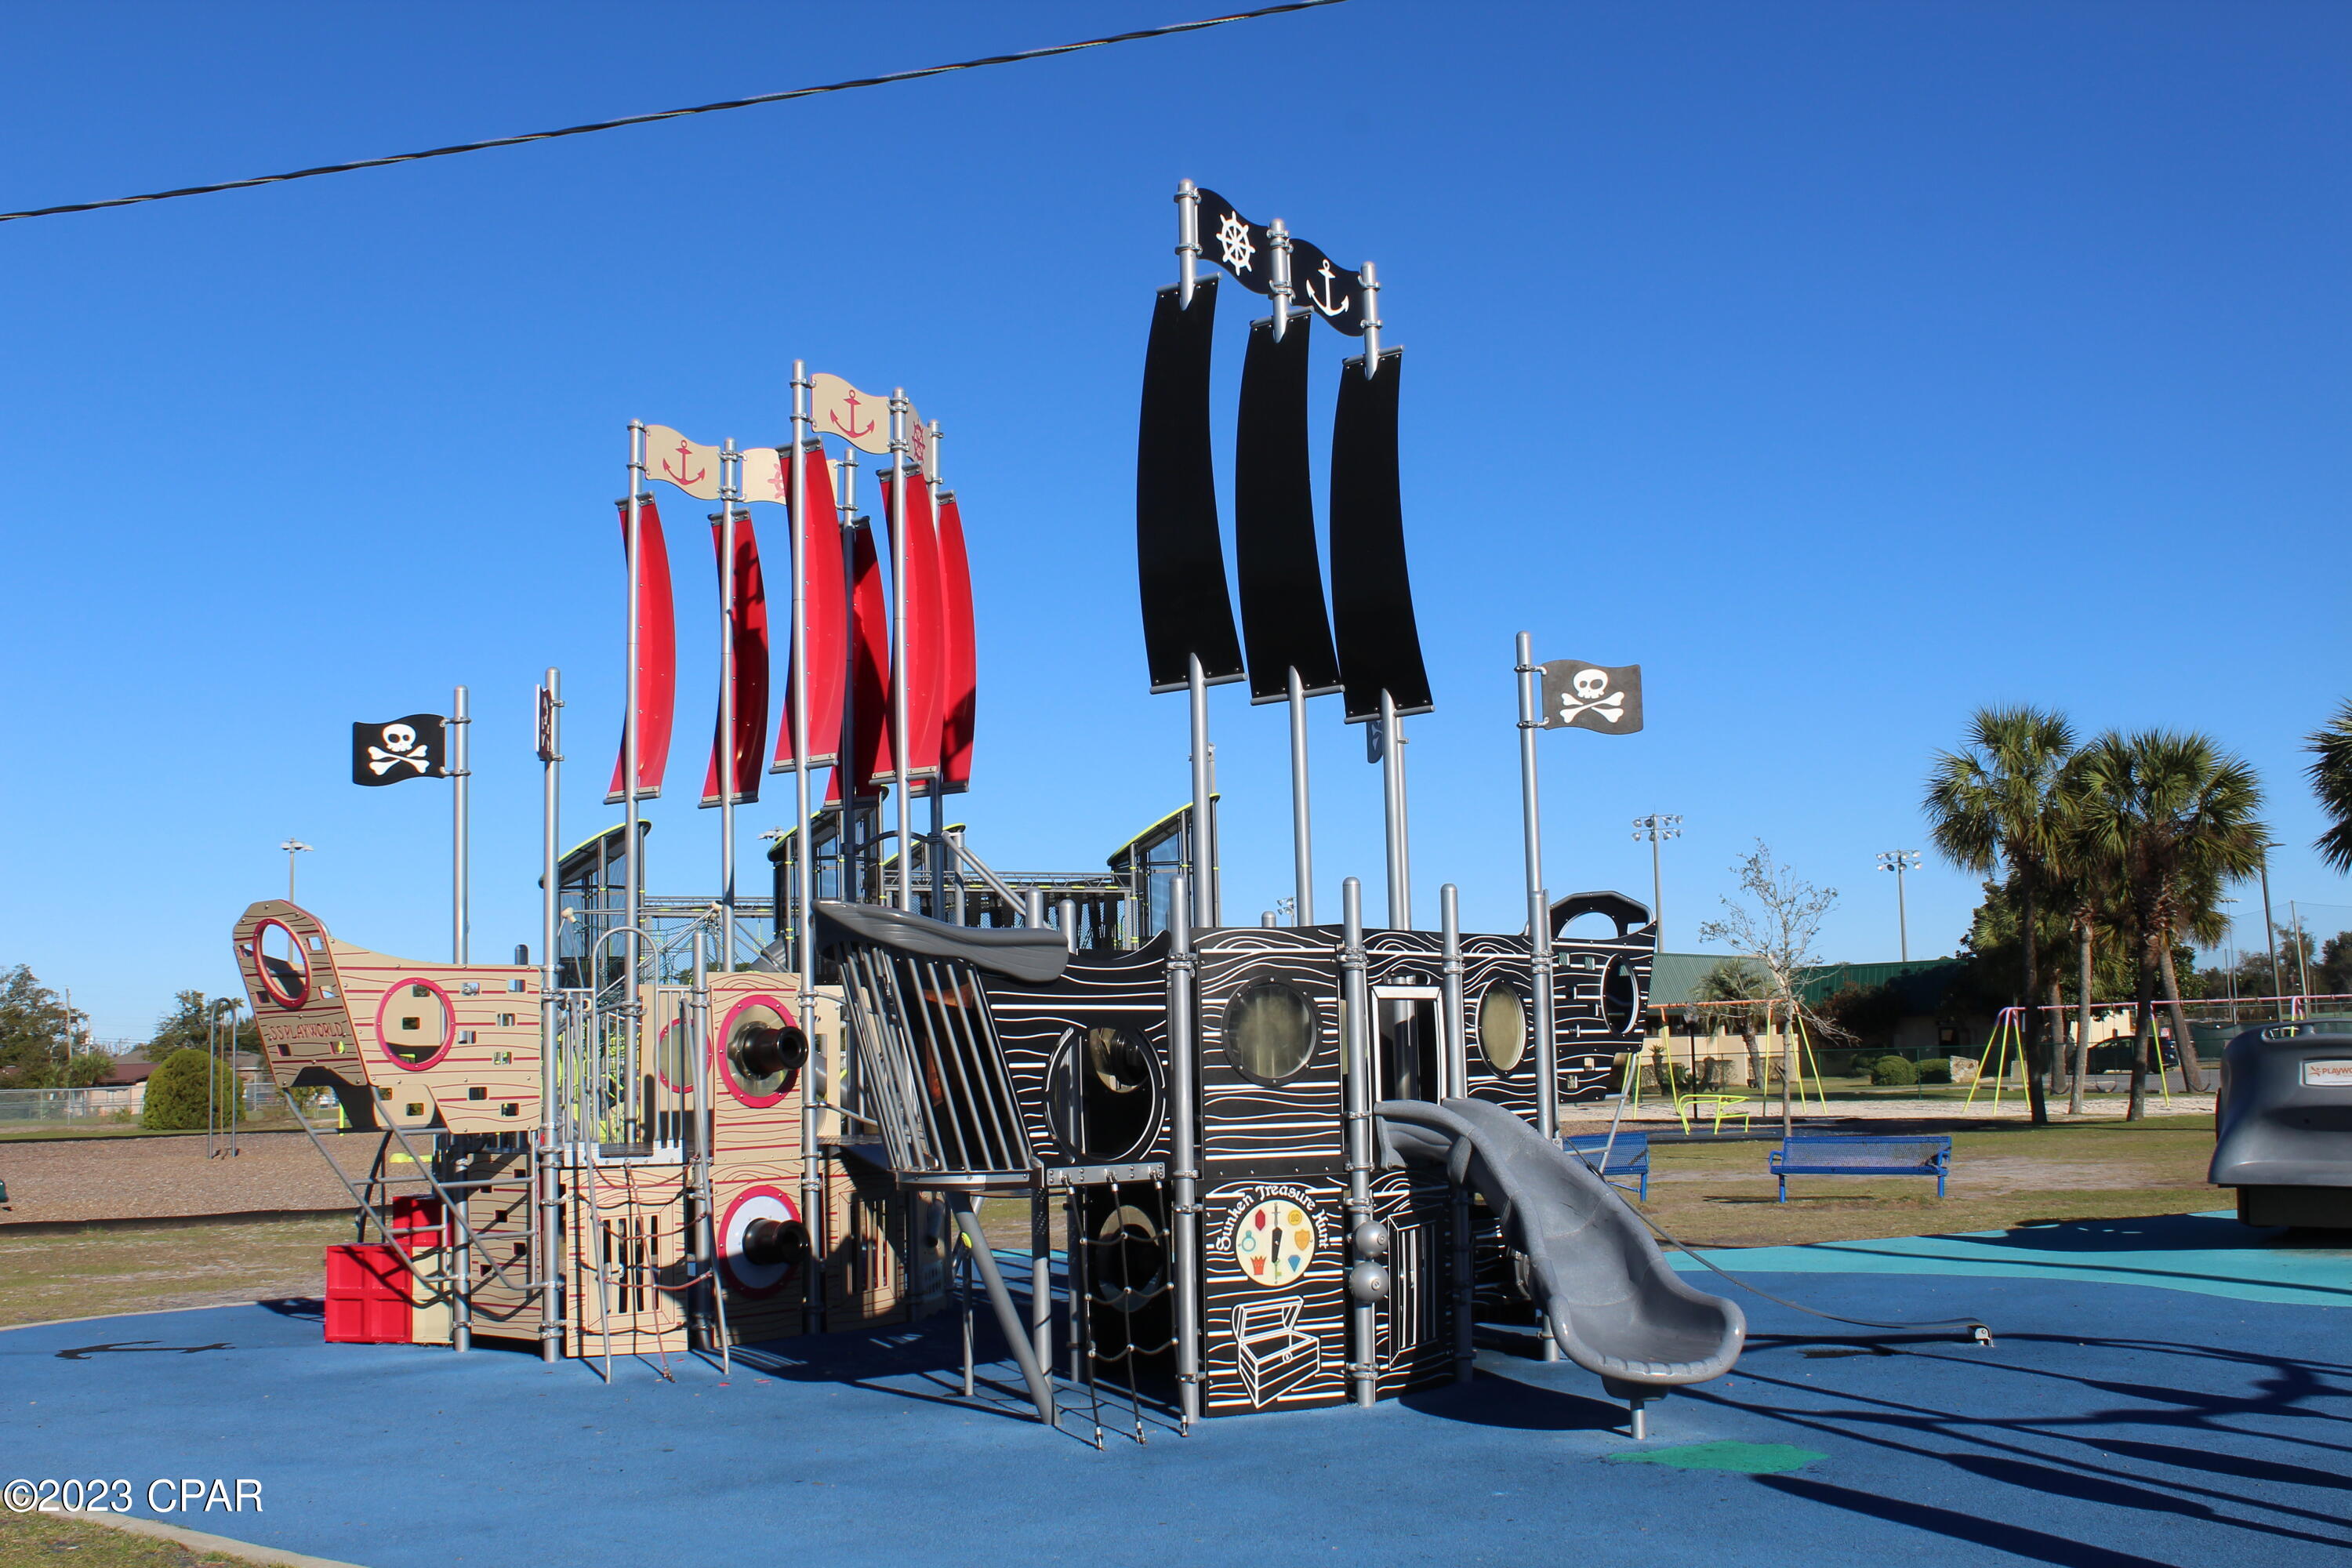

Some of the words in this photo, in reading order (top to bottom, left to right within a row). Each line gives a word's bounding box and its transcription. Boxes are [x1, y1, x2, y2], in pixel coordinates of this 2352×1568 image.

[1216, 1194, 1254, 1250] Sunken
[1254, 1185, 1316, 1210] Treasure
[1312, 1208, 1329, 1249] Hunt
